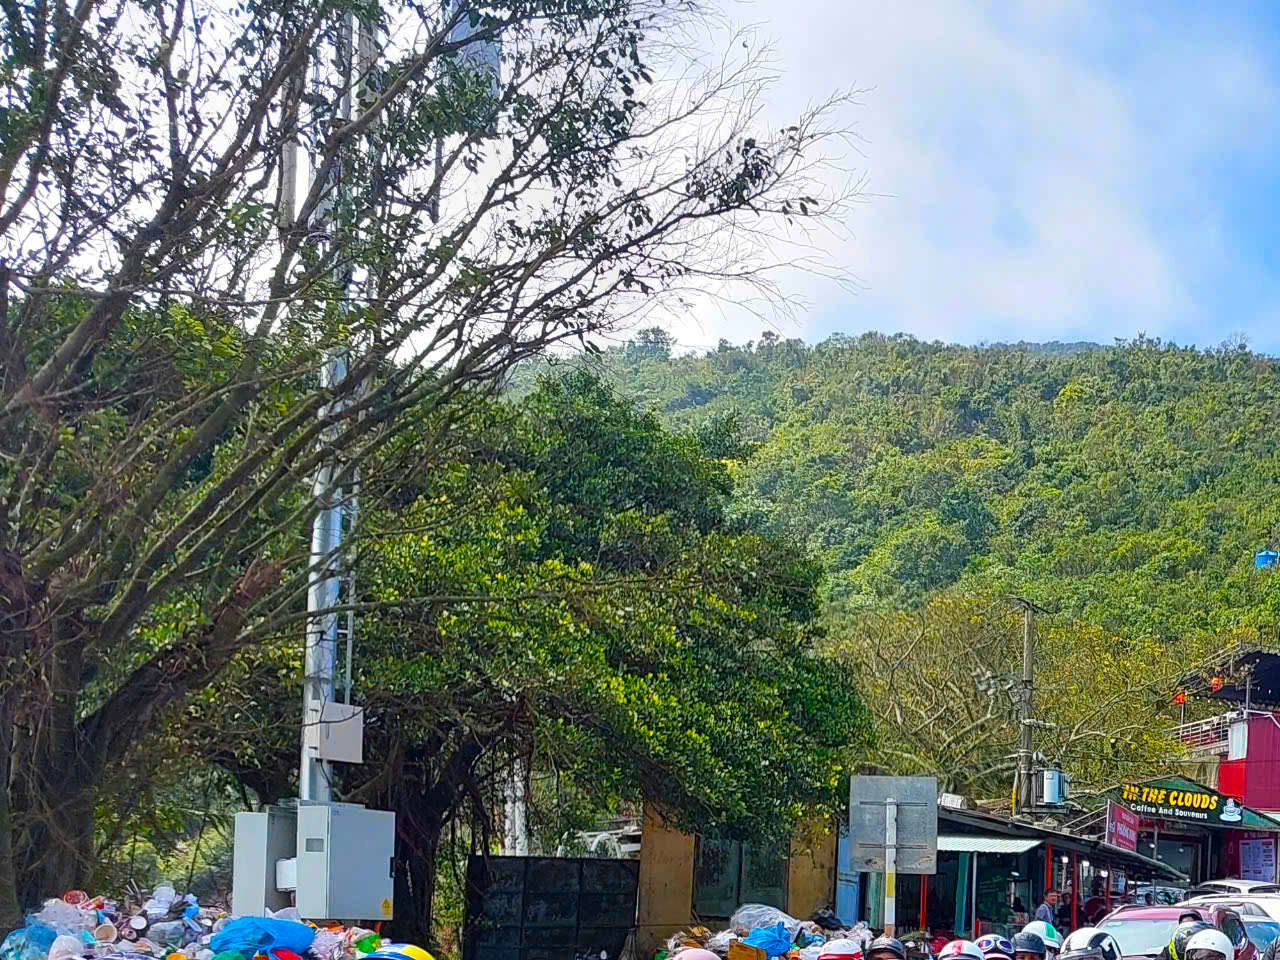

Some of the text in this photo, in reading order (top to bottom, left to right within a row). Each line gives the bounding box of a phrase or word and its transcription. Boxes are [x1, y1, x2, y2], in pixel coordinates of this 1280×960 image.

[1122, 783, 1219, 810] IN THE CLOUDS
[1130, 803, 1208, 819] Coffee And Souvenirs
